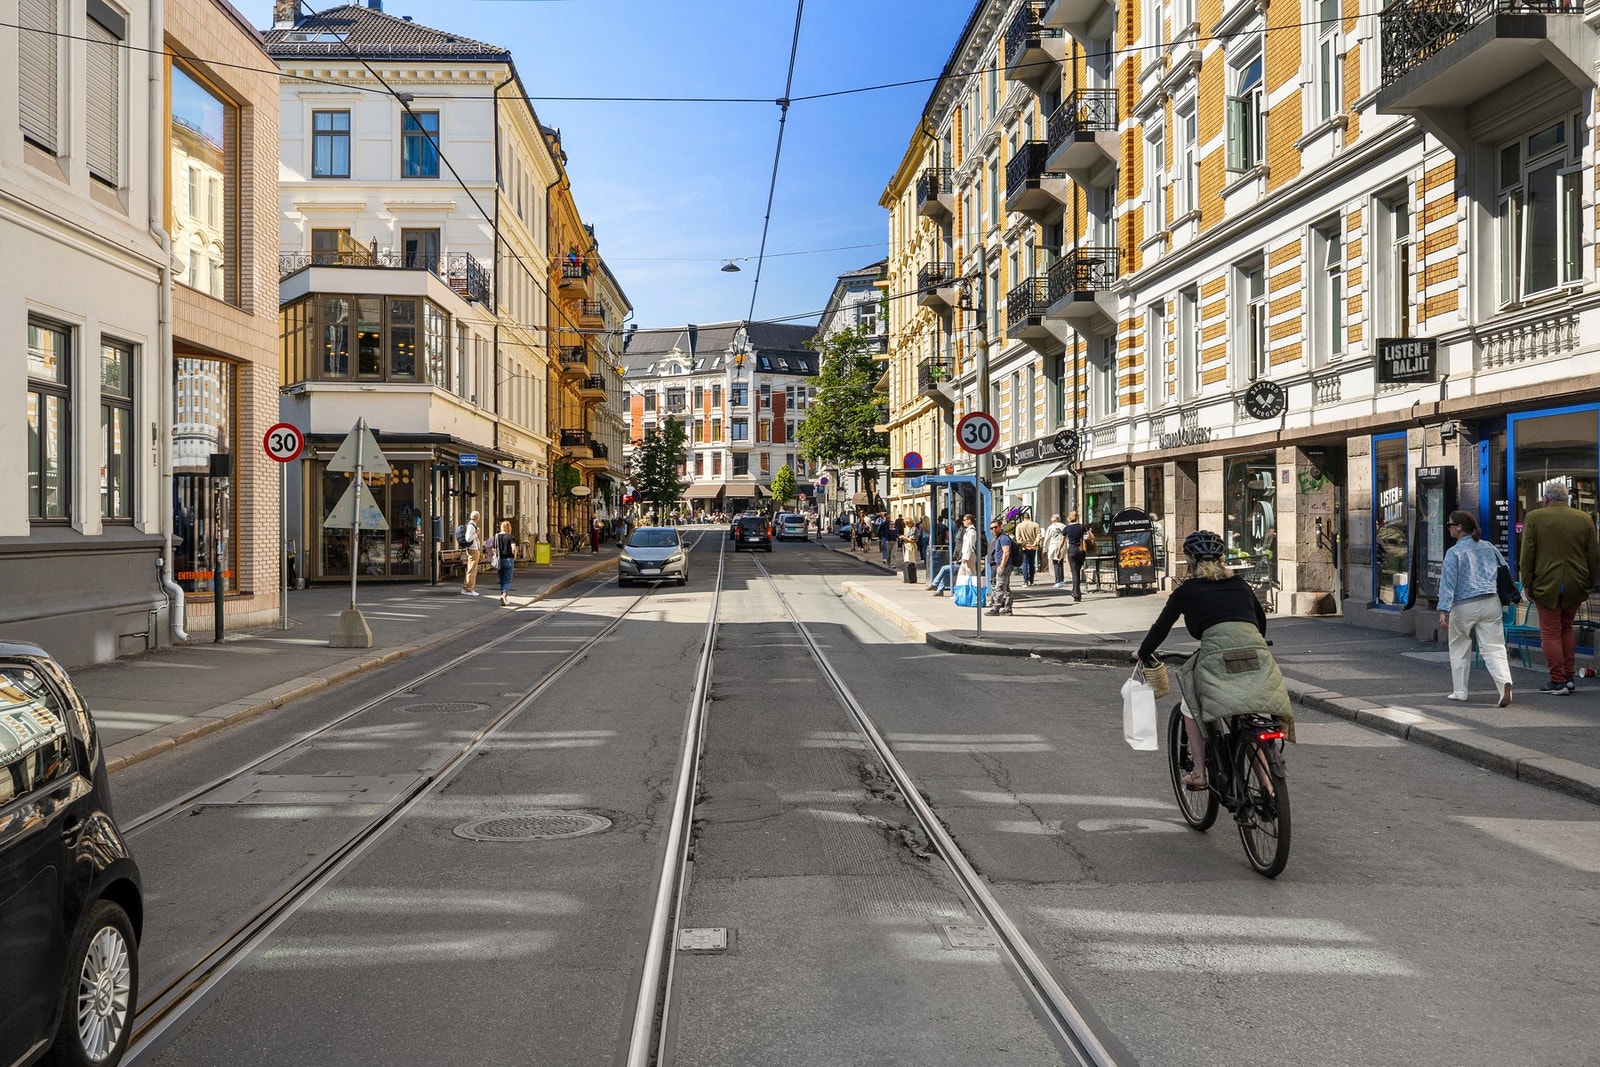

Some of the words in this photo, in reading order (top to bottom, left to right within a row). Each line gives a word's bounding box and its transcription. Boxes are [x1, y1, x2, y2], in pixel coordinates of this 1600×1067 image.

[1385, 342, 1420, 360] LISTEN
[1393, 356, 1429, 374] BALJIT
[1250, 383, 1278, 395] BASTARD
[1252, 405, 1280, 417] BURGERS
[964, 423, 992, 443] 30
[271, 433, 297, 452] 30
